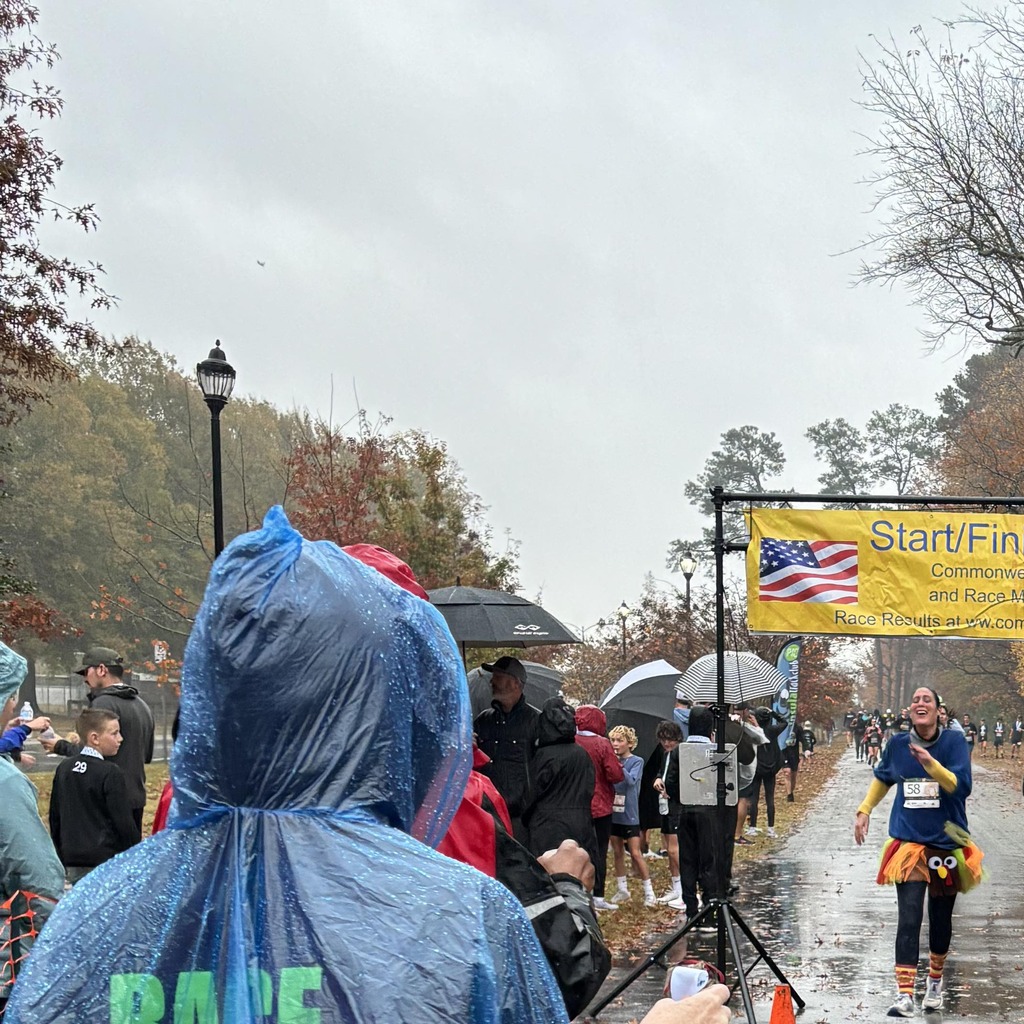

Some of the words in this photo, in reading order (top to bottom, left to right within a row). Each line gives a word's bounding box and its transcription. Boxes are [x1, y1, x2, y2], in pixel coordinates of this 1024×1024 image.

[929, 588, 958, 602] and
[964, 588, 1006, 603] Race
[834, 609, 877, 625] Race
[882, 611, 941, 628] Results
[946, 615, 961, 627] at
[72, 760, 88, 774] 29
[906, 783, 921, 795] 58
